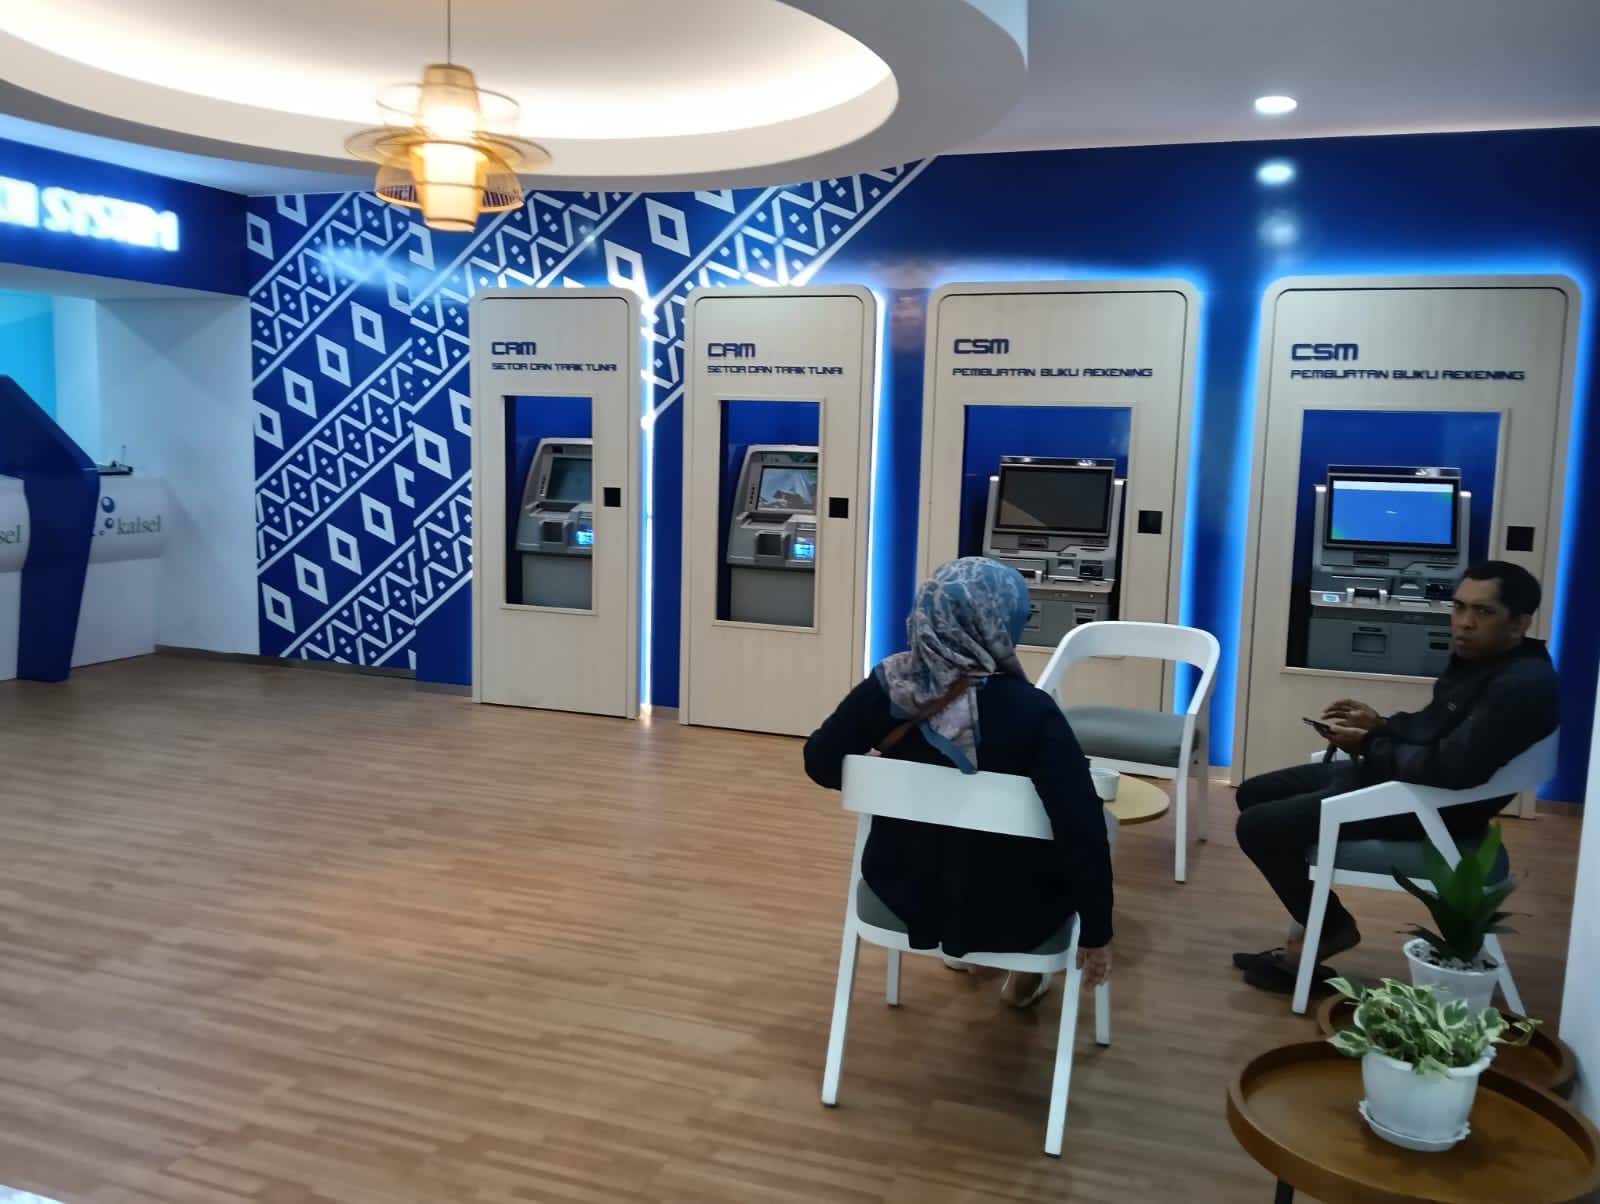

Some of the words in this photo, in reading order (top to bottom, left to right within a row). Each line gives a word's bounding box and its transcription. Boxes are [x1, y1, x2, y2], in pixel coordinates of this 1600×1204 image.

[491, 341, 536, 356] CAM
[707, 342, 756, 358] CAM
[953, 338, 1009, 354] CSM
[1291, 343, 1359, 361] CSM
[491, 362, 528, 371] SETOR
[529, 363, 552, 371] DAN
[707, 365, 746, 374] SETOR
[748, 366, 773, 374] DAN
[951, 367, 1036, 377] PEMBUATAN
[1040, 367, 1079, 377] BUKU
[1082, 368, 1153, 377] REKENING
[1290, 369, 1389, 380] PEMBUATAN
[1392, 370, 1439, 380] BUKU
[1441, 370, 1525, 381] REKENING
[116, 514, 162, 536] kalsel
